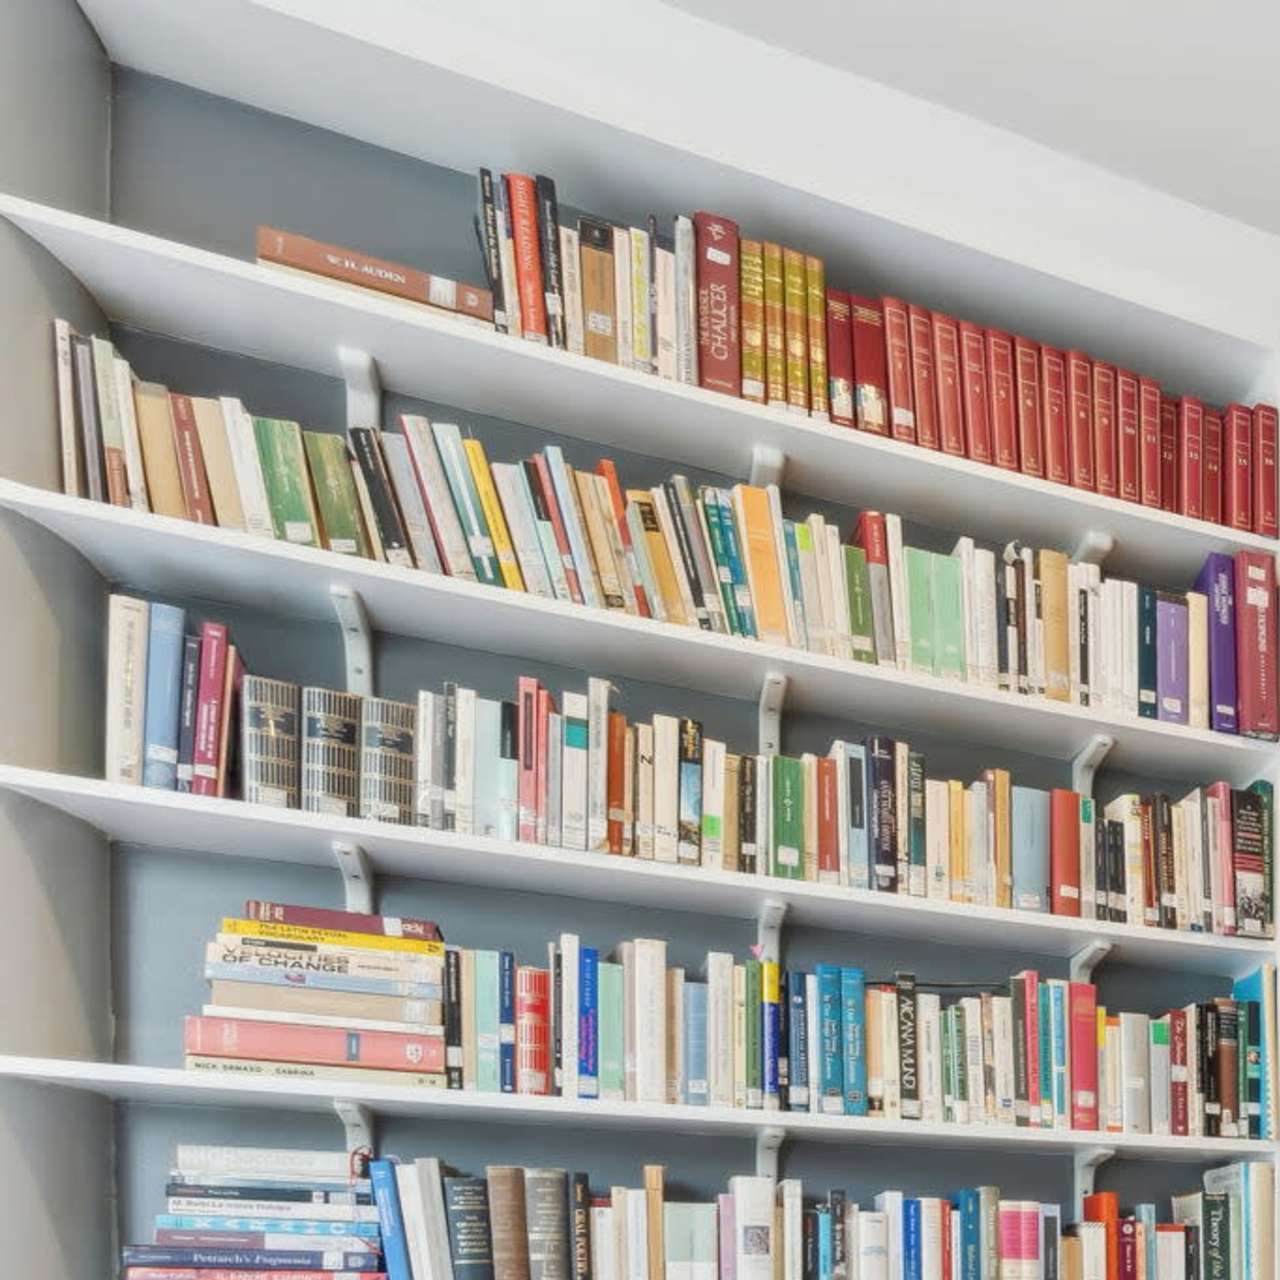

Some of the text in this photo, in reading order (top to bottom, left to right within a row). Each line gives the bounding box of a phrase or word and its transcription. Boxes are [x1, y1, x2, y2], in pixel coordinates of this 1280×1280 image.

[361, 263, 406, 285] AUDEN
[710, 282, 729, 361] CHAUCER
[222, 953, 351, 974] OF CHANGE
[223, 944, 351, 966] VELOCITIES
[900, 996, 917, 1089] ARCANA MUNDI
[1208, 1209, 1223, 1245] Theory
[193, 1253, 251, 1264] Petrarch's
[1208, 1247, 1222, 1260] of
[1210, 1261, 1223, 1278] the
